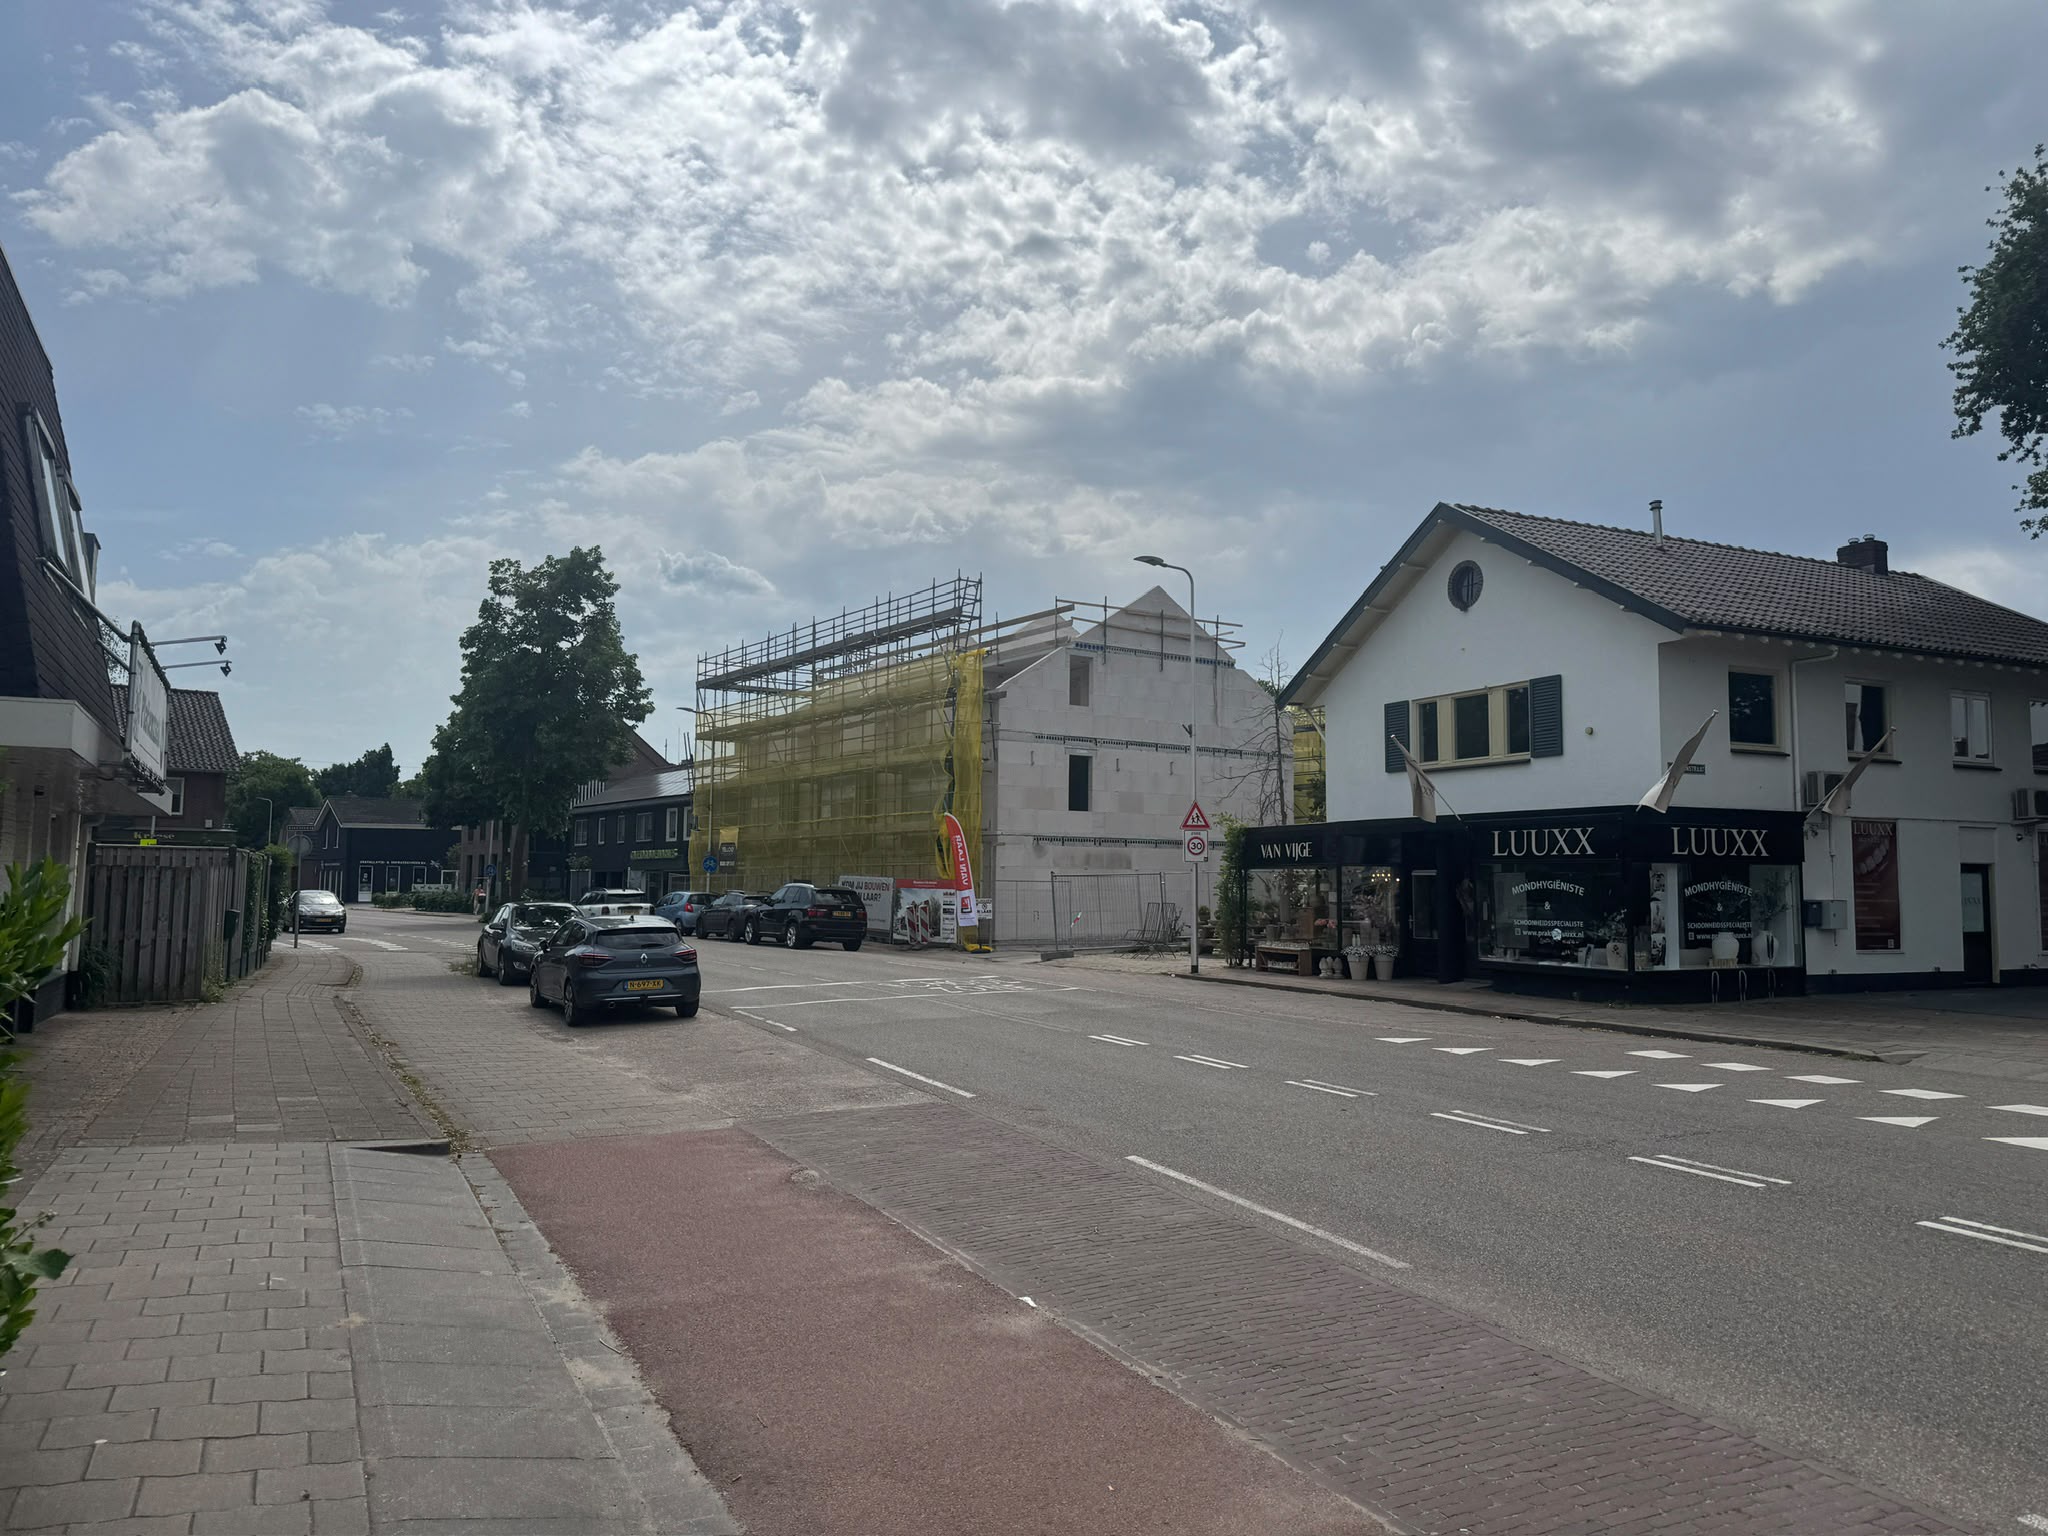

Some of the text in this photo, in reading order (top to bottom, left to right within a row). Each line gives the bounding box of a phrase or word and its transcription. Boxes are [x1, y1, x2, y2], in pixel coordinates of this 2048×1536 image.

[1190, 842, 1202, 850] 30
[1491, 827, 1596, 856] LUUXX
[1671, 827, 1770, 857] LUUXX
[1260, 841, 1312, 862] VAN VIJGE
[864, 882, 890, 892] BOUWEN
[1511, 879, 1585, 897] MONDHYGIËNISTE
[1684, 880, 1753, 897] MONDHYGIËNISTE
[863, 892, 881, 902] LAAR?
[1544, 901, 1551, 910] &
[1716, 902, 1723, 912] &
[1513, 919, 1584, 928] SCHOONHEIDSSPECIALISTE
